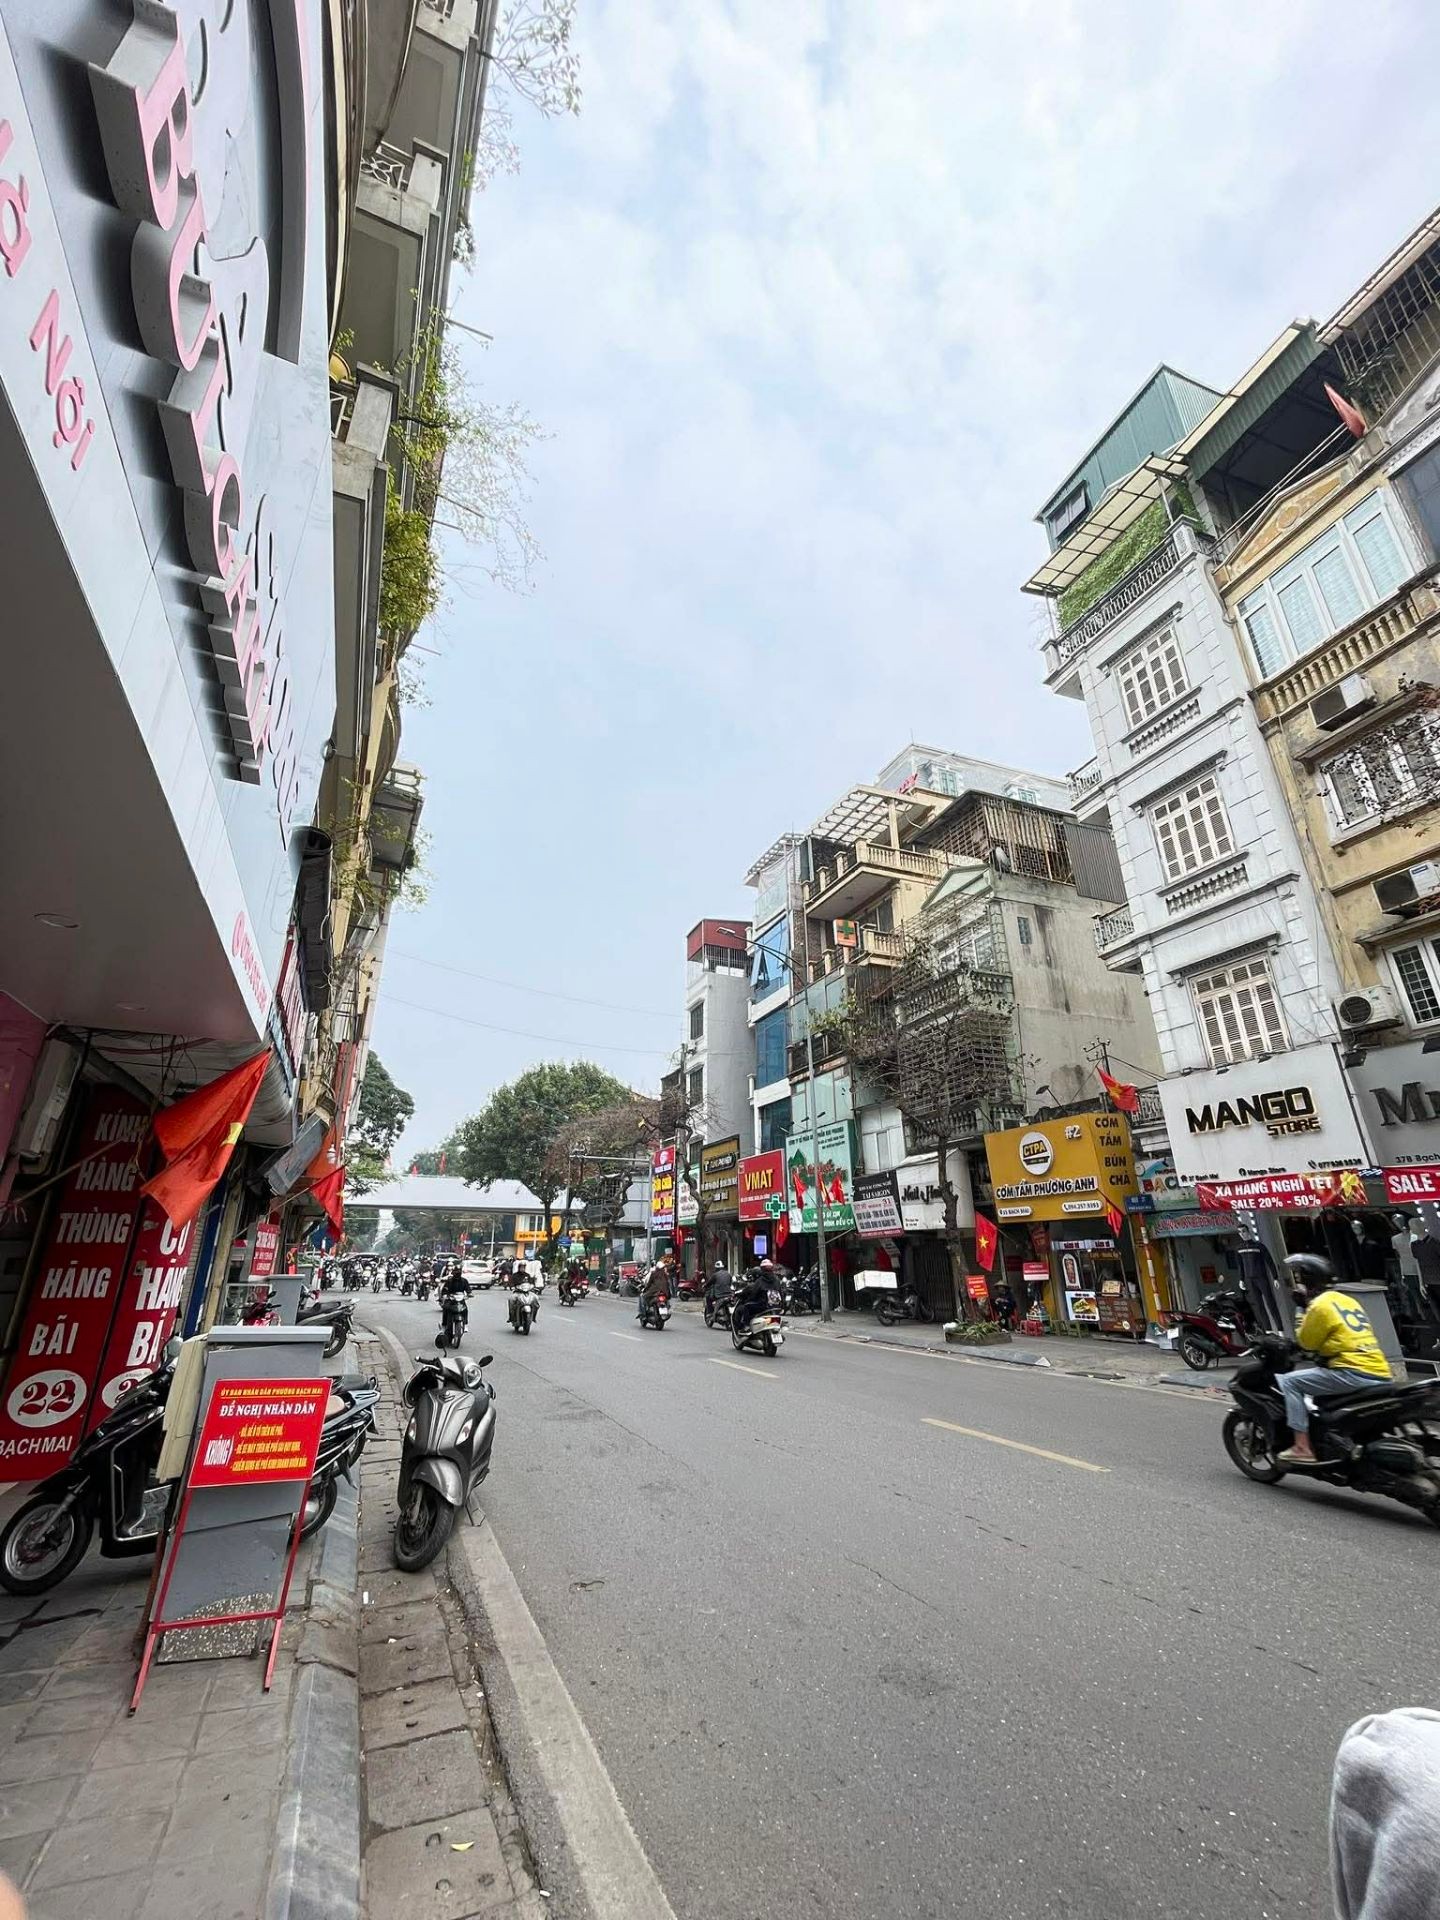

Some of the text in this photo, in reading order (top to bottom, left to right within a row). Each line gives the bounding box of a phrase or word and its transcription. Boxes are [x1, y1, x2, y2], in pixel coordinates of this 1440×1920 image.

[30, 288, 96, 472] Nội
[1185, 1086, 1316, 1133] MANGO
[1095, 1115, 1119, 1128] CƠM
[1266, 1116, 1321, 1136] STORE
[1024, 1140, 1046, 1156] CTPA
[1099, 1131, 1122, 1147] TẤM
[1104, 1153, 1127, 1167] BÚN
[745, 1168, 773, 1191] VMAT
[996, 1177, 1096, 1199] CƠM TẤM PHƯƠNG ANH
[1109, 1171, 1131, 1186] CHẢ
[1388, 1173, 1436, 1194] SALE
[1230, 1199, 1257, 1210] SALE
[1258, 1196, 1283, 1209] 20%
[1293, 1194, 1321, 1206] 50%
[56, 1206, 132, 1244] THÙNG
[40, 1260, 112, 1299] HÀNG
[28, 1314, 80, 1356] BÃI
[18, 1380, 76, 1416] 22
[235, 1404, 263, 1418] NGHỊ
[263, 1401, 293, 1416] NHÂN
[294, 1400, 316, 1415] DÂN
